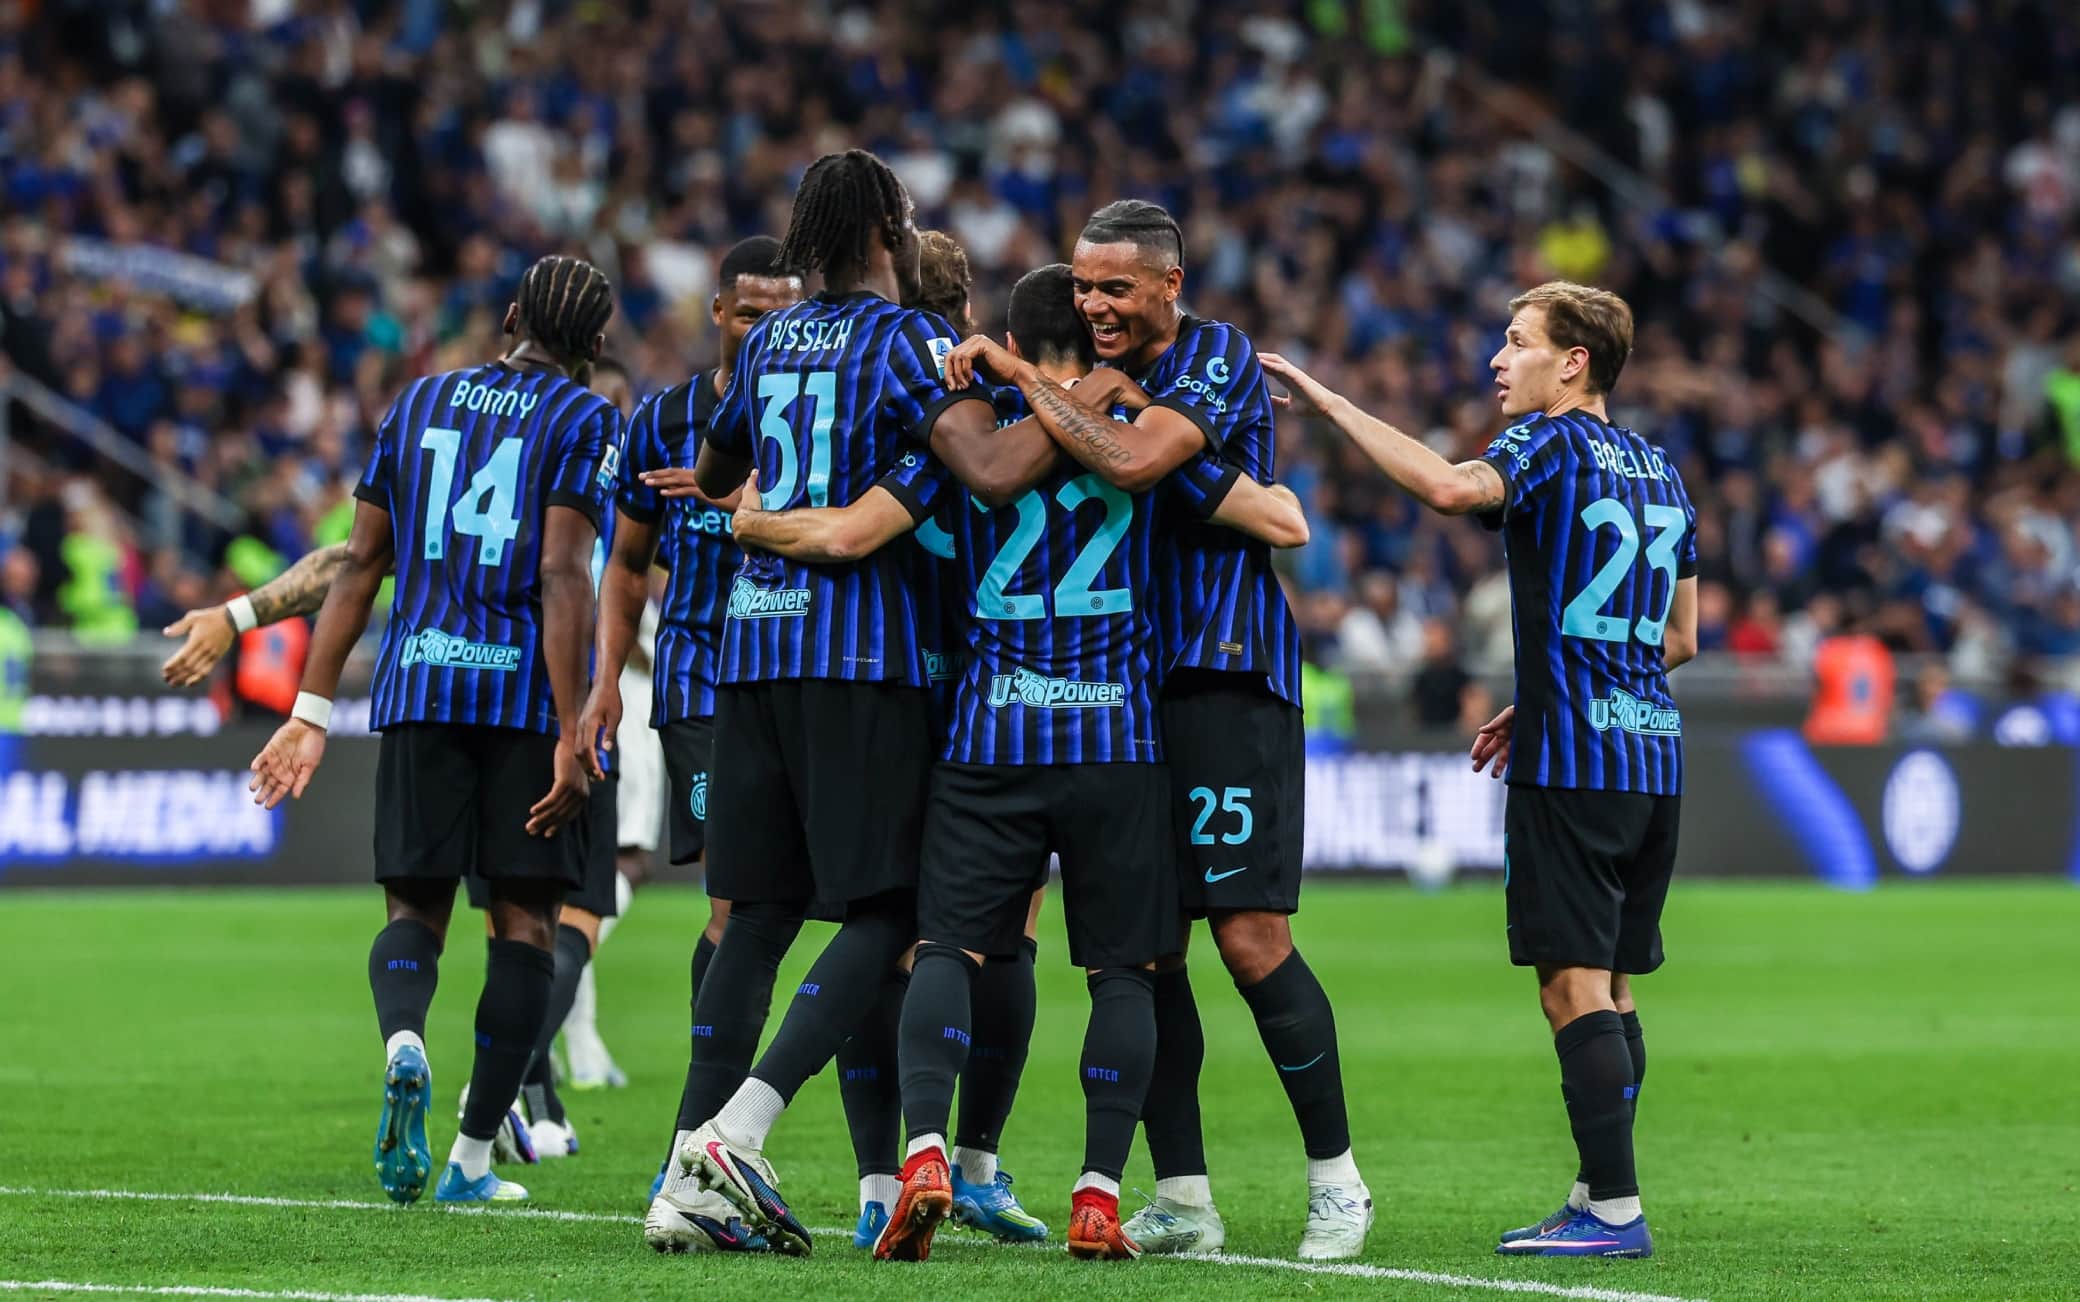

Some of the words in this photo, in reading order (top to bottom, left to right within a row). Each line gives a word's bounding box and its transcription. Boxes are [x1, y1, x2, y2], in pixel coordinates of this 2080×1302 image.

[768, 319, 853, 352] BISSECK
[450, 380, 538, 419] BONNY
[1176, 375, 1226, 412] Gate.io
[758, 372, 836, 511] 31
[1488, 439, 1530, 470] ate.io
[420, 428, 523, 566] 14
[976, 474, 1133, 620] 22
[1562, 498, 1687, 646] 23
[1189, 787, 1253, 845] 25
